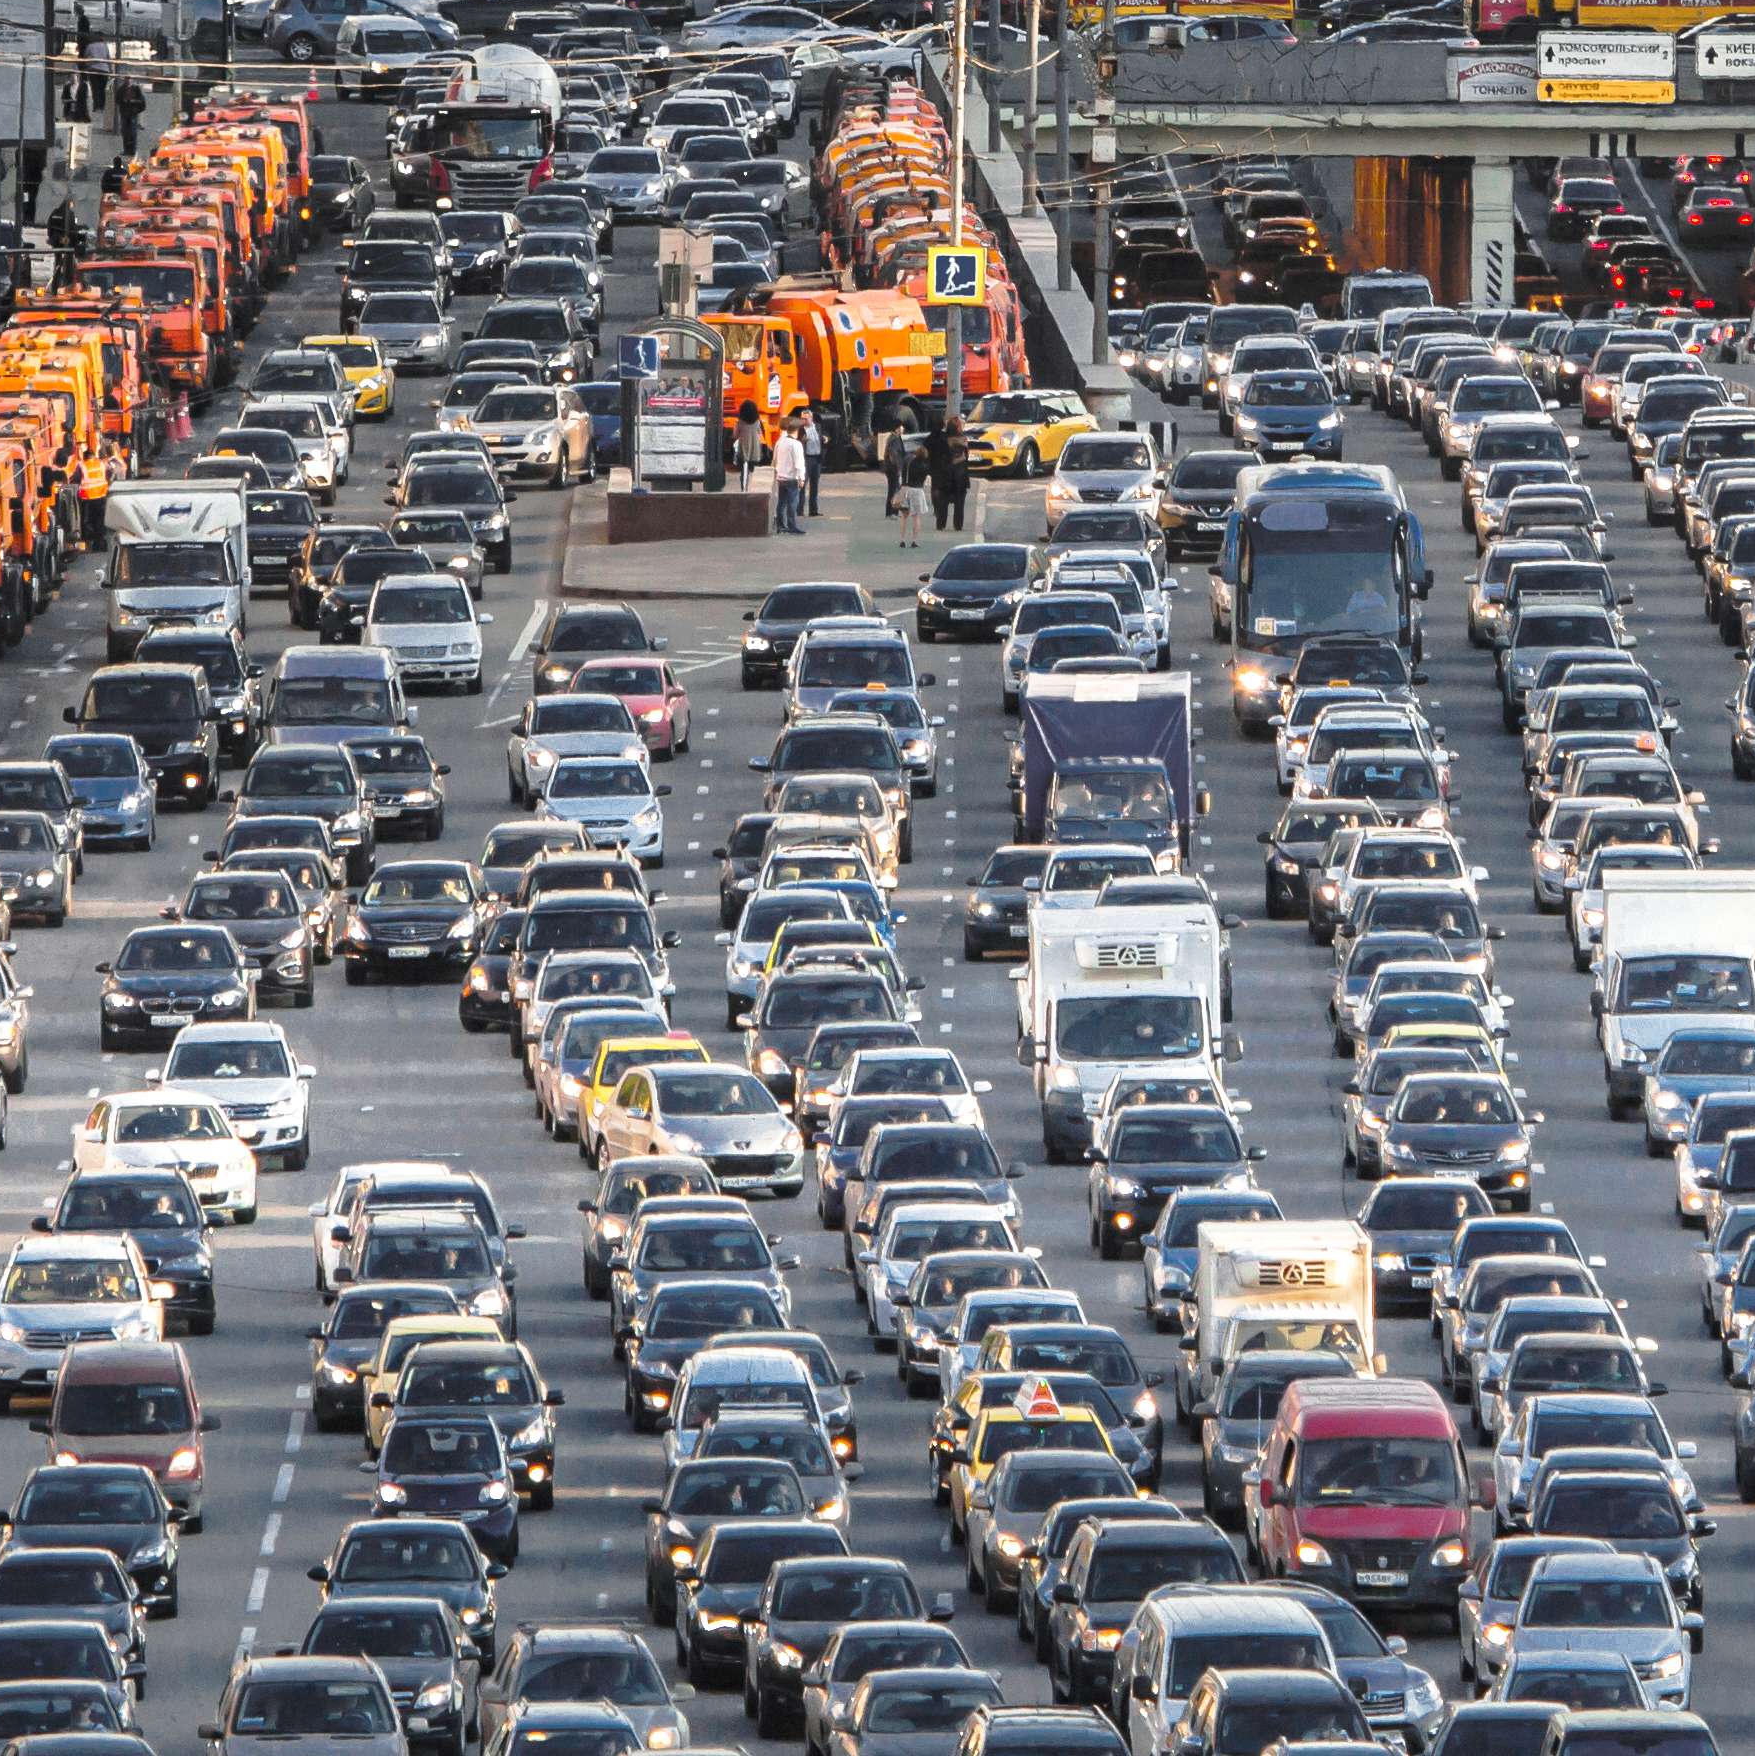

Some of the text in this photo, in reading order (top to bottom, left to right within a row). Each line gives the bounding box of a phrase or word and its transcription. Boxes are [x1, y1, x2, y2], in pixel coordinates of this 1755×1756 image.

[1558, 43, 1660, 53] КОМСОМОЛЬСКИЙ
[1558, 56, 1606, 67] проспект
[1473, 84, 1527, 96] ТОННЕЛЬ
